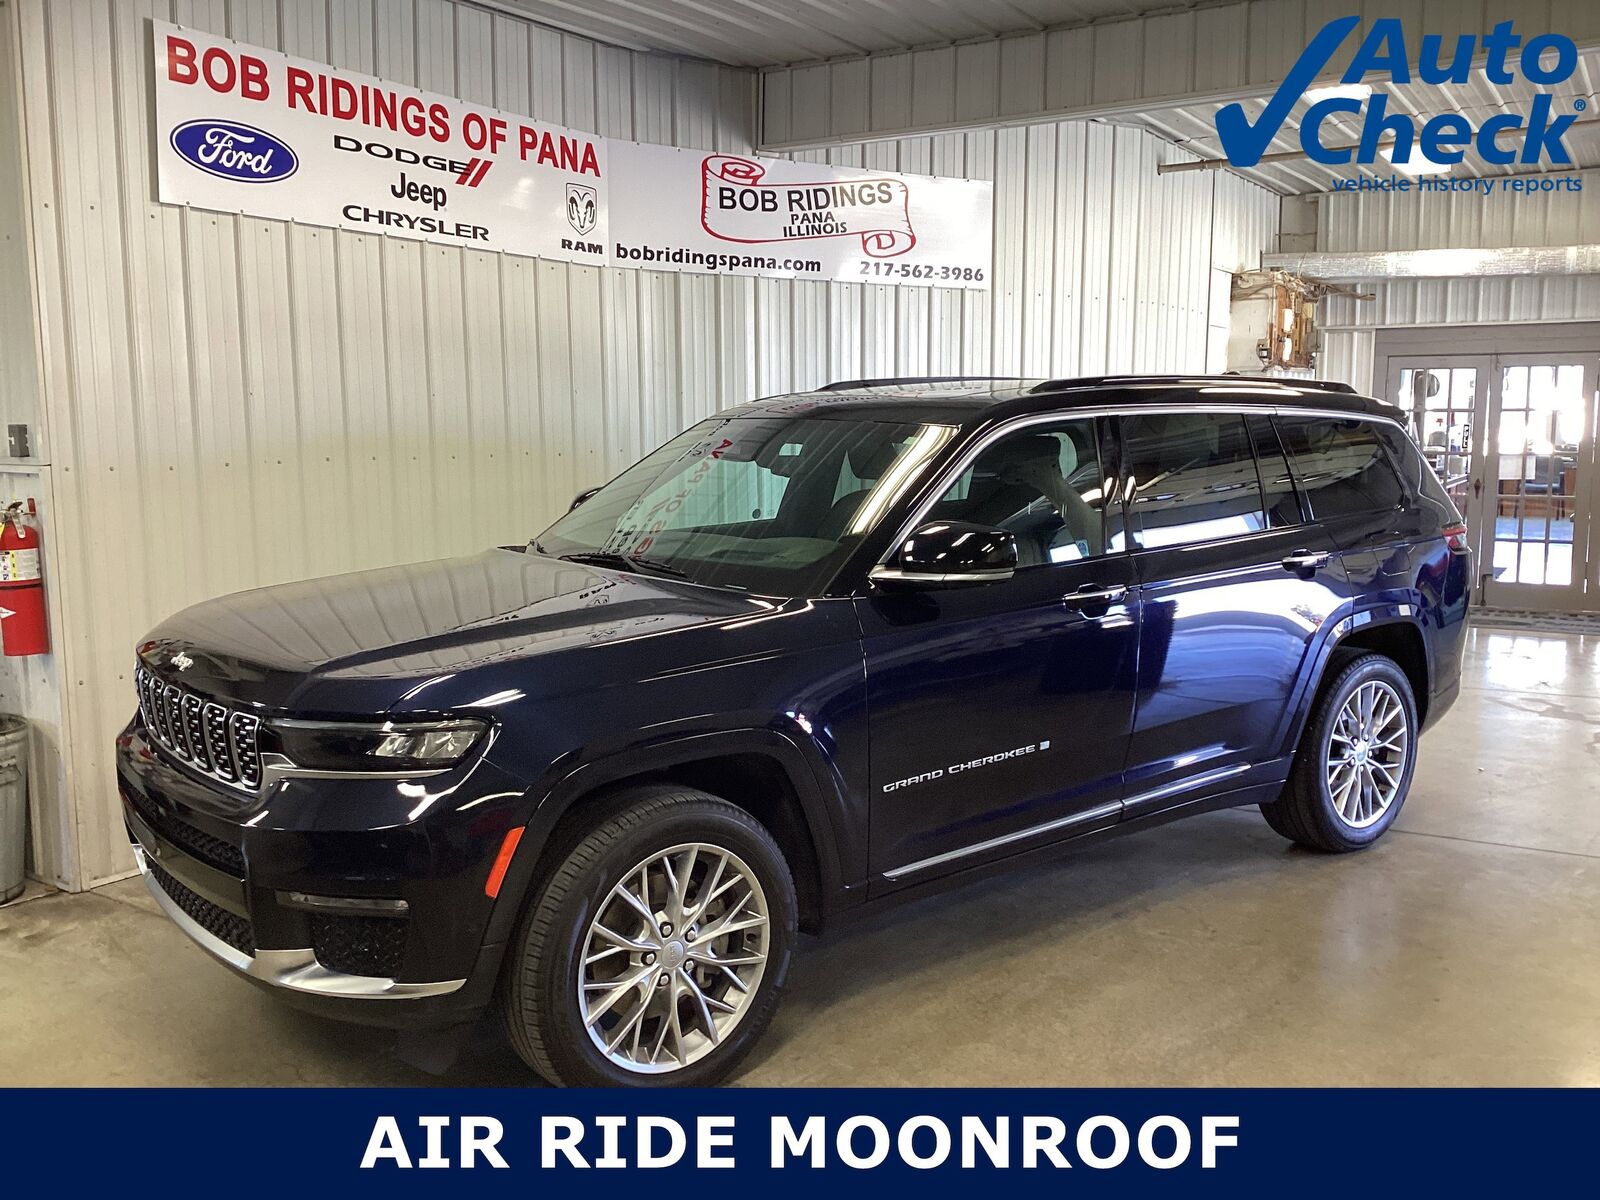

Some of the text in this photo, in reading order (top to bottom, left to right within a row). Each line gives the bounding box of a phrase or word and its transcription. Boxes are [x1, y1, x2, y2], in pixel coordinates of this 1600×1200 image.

[166, 35, 601, 177] BOB RIDINGS OF PANA
[198, 127, 274, 174] Ford
[333, 134, 471, 175] DODGE
[390, 172, 447, 211] Jeep
[718, 182, 893, 213] BOB RIDINGS
[342, 204, 490, 242] CHRYSLER
[782, 221, 848, 238] ILLINOIS
[790, 211, 836, 226] PANA
[561, 238, 603, 255] RAM
[615, 242, 821, 273] bobridingspana.com
[859, 260, 985, 283] 217-562-3986
[882, 744, 1036, 793] GRAND CHEROKEE
